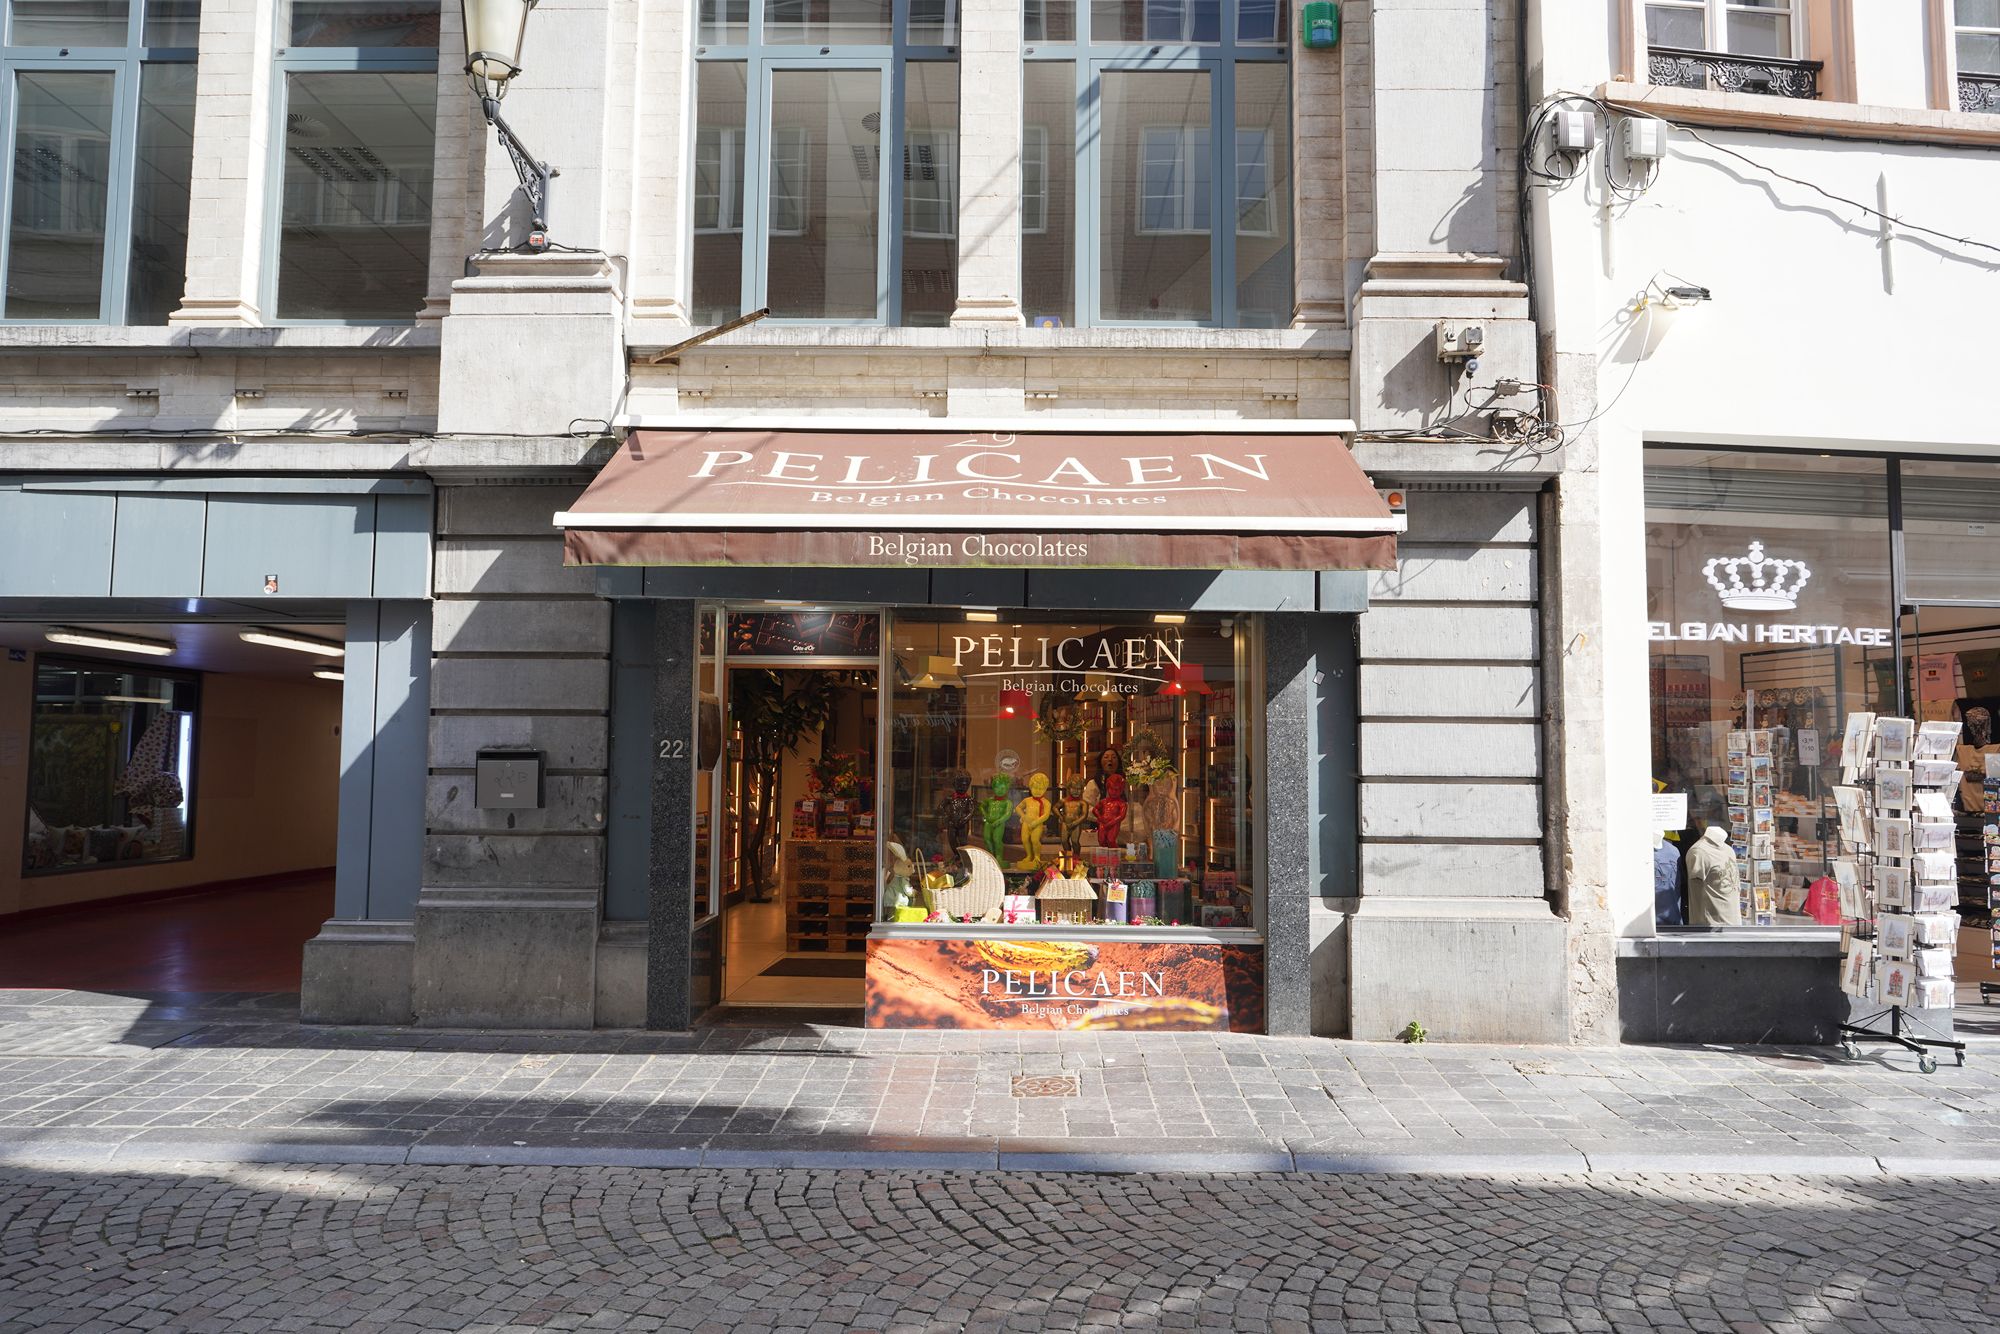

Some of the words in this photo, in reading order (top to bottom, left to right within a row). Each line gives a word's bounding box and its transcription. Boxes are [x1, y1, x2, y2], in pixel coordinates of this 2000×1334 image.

[689, 450, 1270, 485] PELICAEN
[810, 490, 945, 506] Belgian
[963, 487, 1167, 504] Chocolates
[868, 534, 953, 564] Belgian
[962, 535, 1089, 558] Chocolates
[1755, 624, 1892, 646] HERITAGE
[952, 635, 1185, 669] PELICAEN
[1003, 679, 1054, 696] Belgian
[1060, 679, 1139, 694] Chocolates
[659, 739, 684, 758] 22
[981, 970, 1164, 996] PELICAEN
[1021, 1003, 1063, 1018] Belgian
[1067, 1004, 1129, 1016] Chocolates
